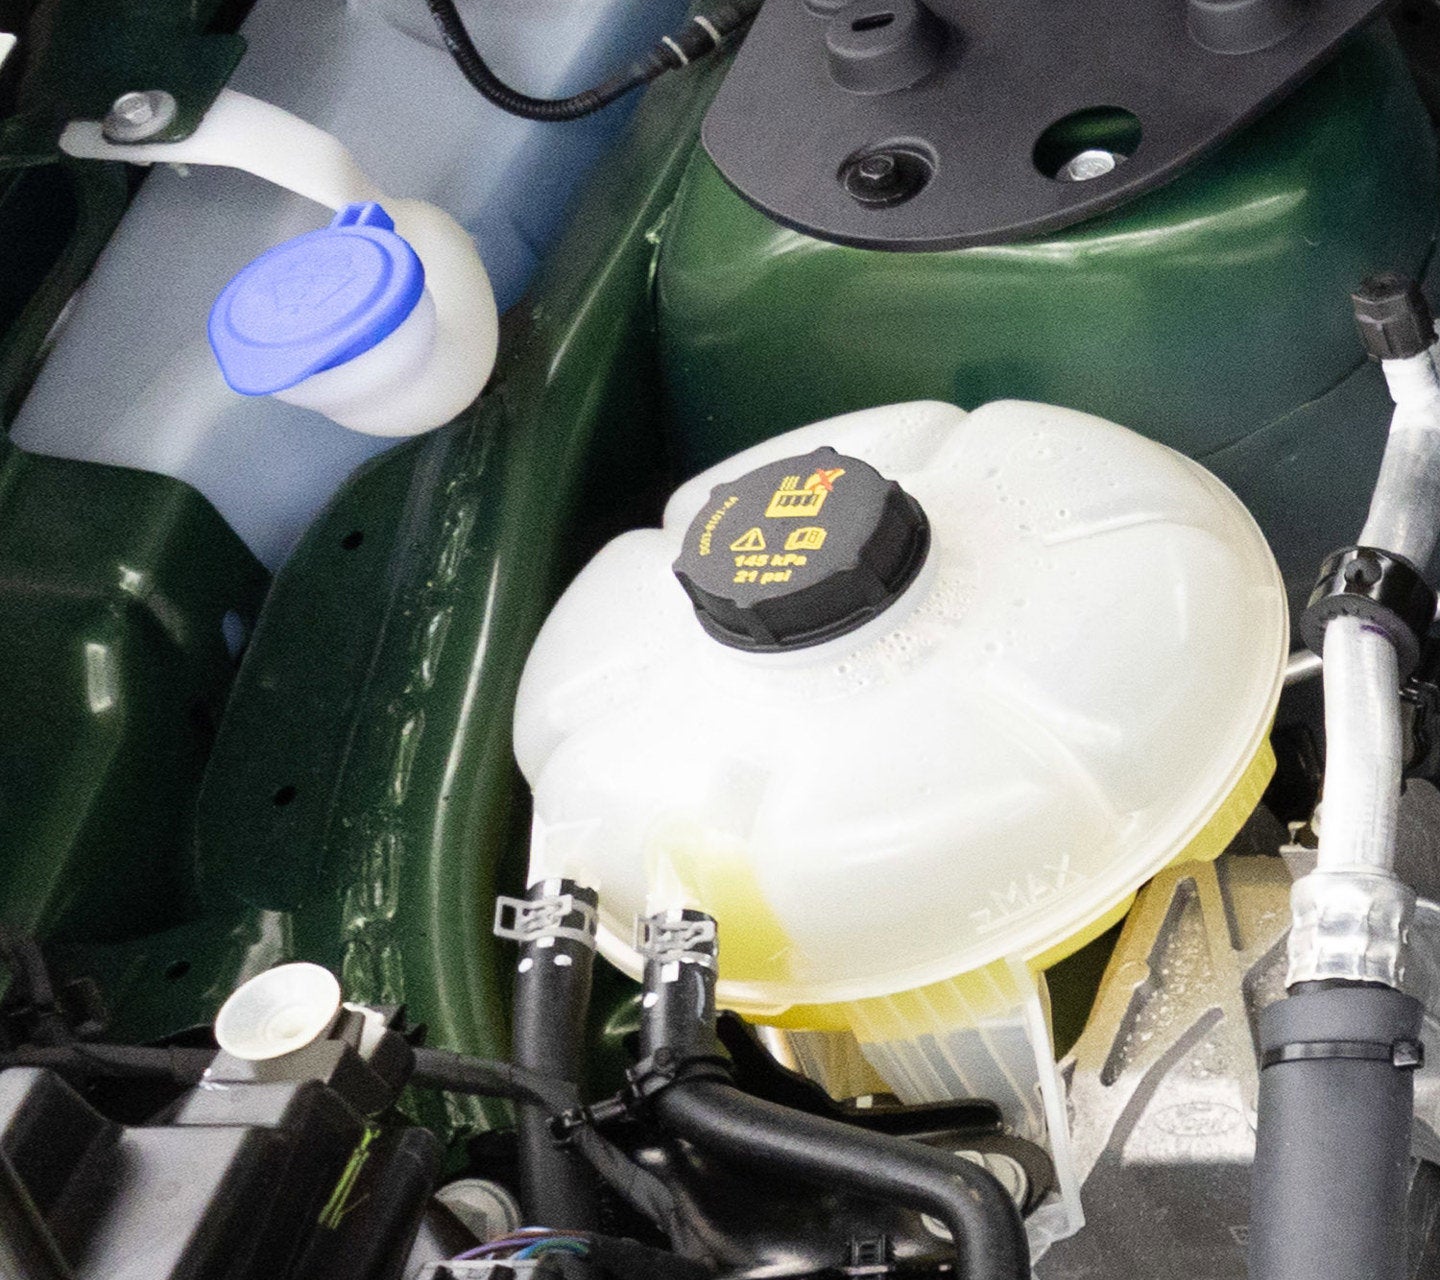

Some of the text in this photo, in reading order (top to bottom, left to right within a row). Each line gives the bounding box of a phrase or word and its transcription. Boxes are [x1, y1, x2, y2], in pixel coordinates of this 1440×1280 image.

[734, 553, 807, 568] 145 kPa
[734, 569, 793, 585] 21 psi
